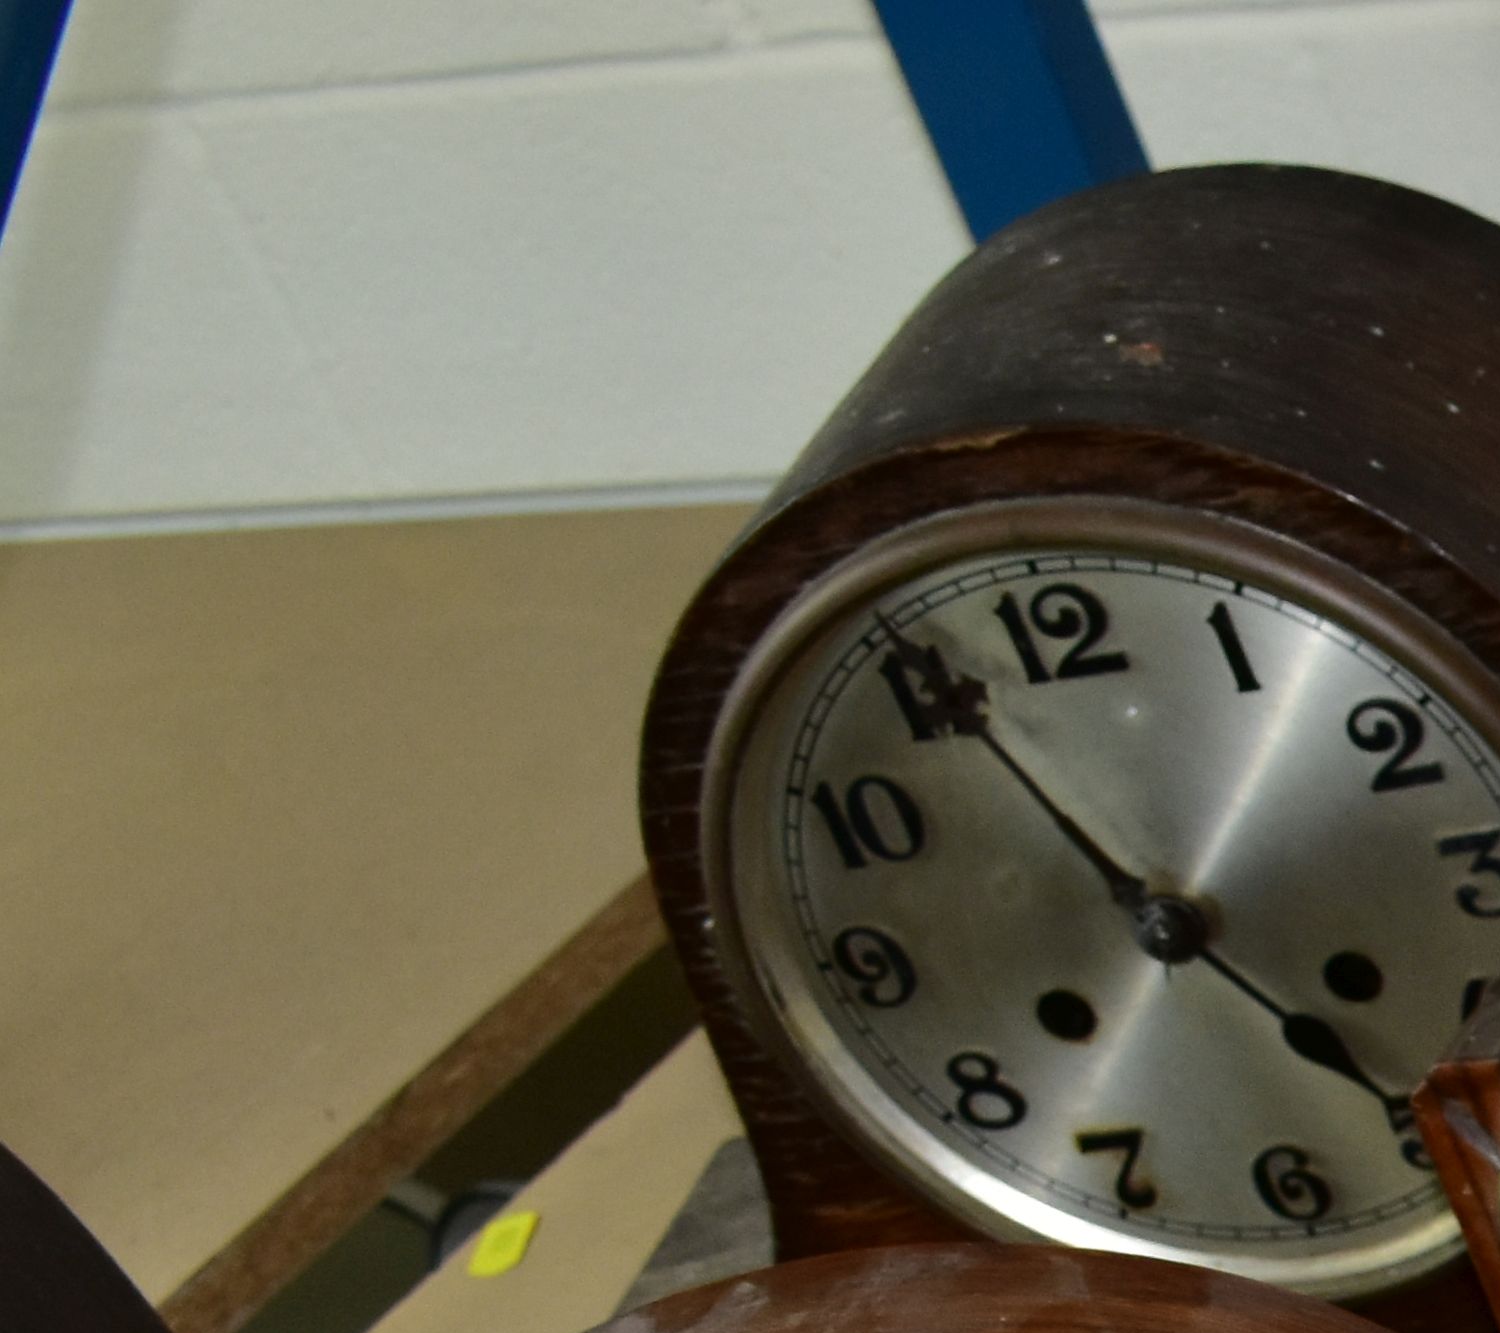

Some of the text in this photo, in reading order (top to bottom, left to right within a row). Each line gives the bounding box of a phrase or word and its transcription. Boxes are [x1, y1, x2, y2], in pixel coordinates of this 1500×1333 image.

[993, 583, 1130, 684] 12
[1207, 601, 1262, 693] 1
[1346, 698, 1445, 792] 2
[809, 773, 925, 869] 10
[833, 926, 917, 1006] 9
[946, 1051, 1027, 1130] 8
[1075, 1127, 1157, 1210] 7
[1251, 1144, 1332, 1221] 6
